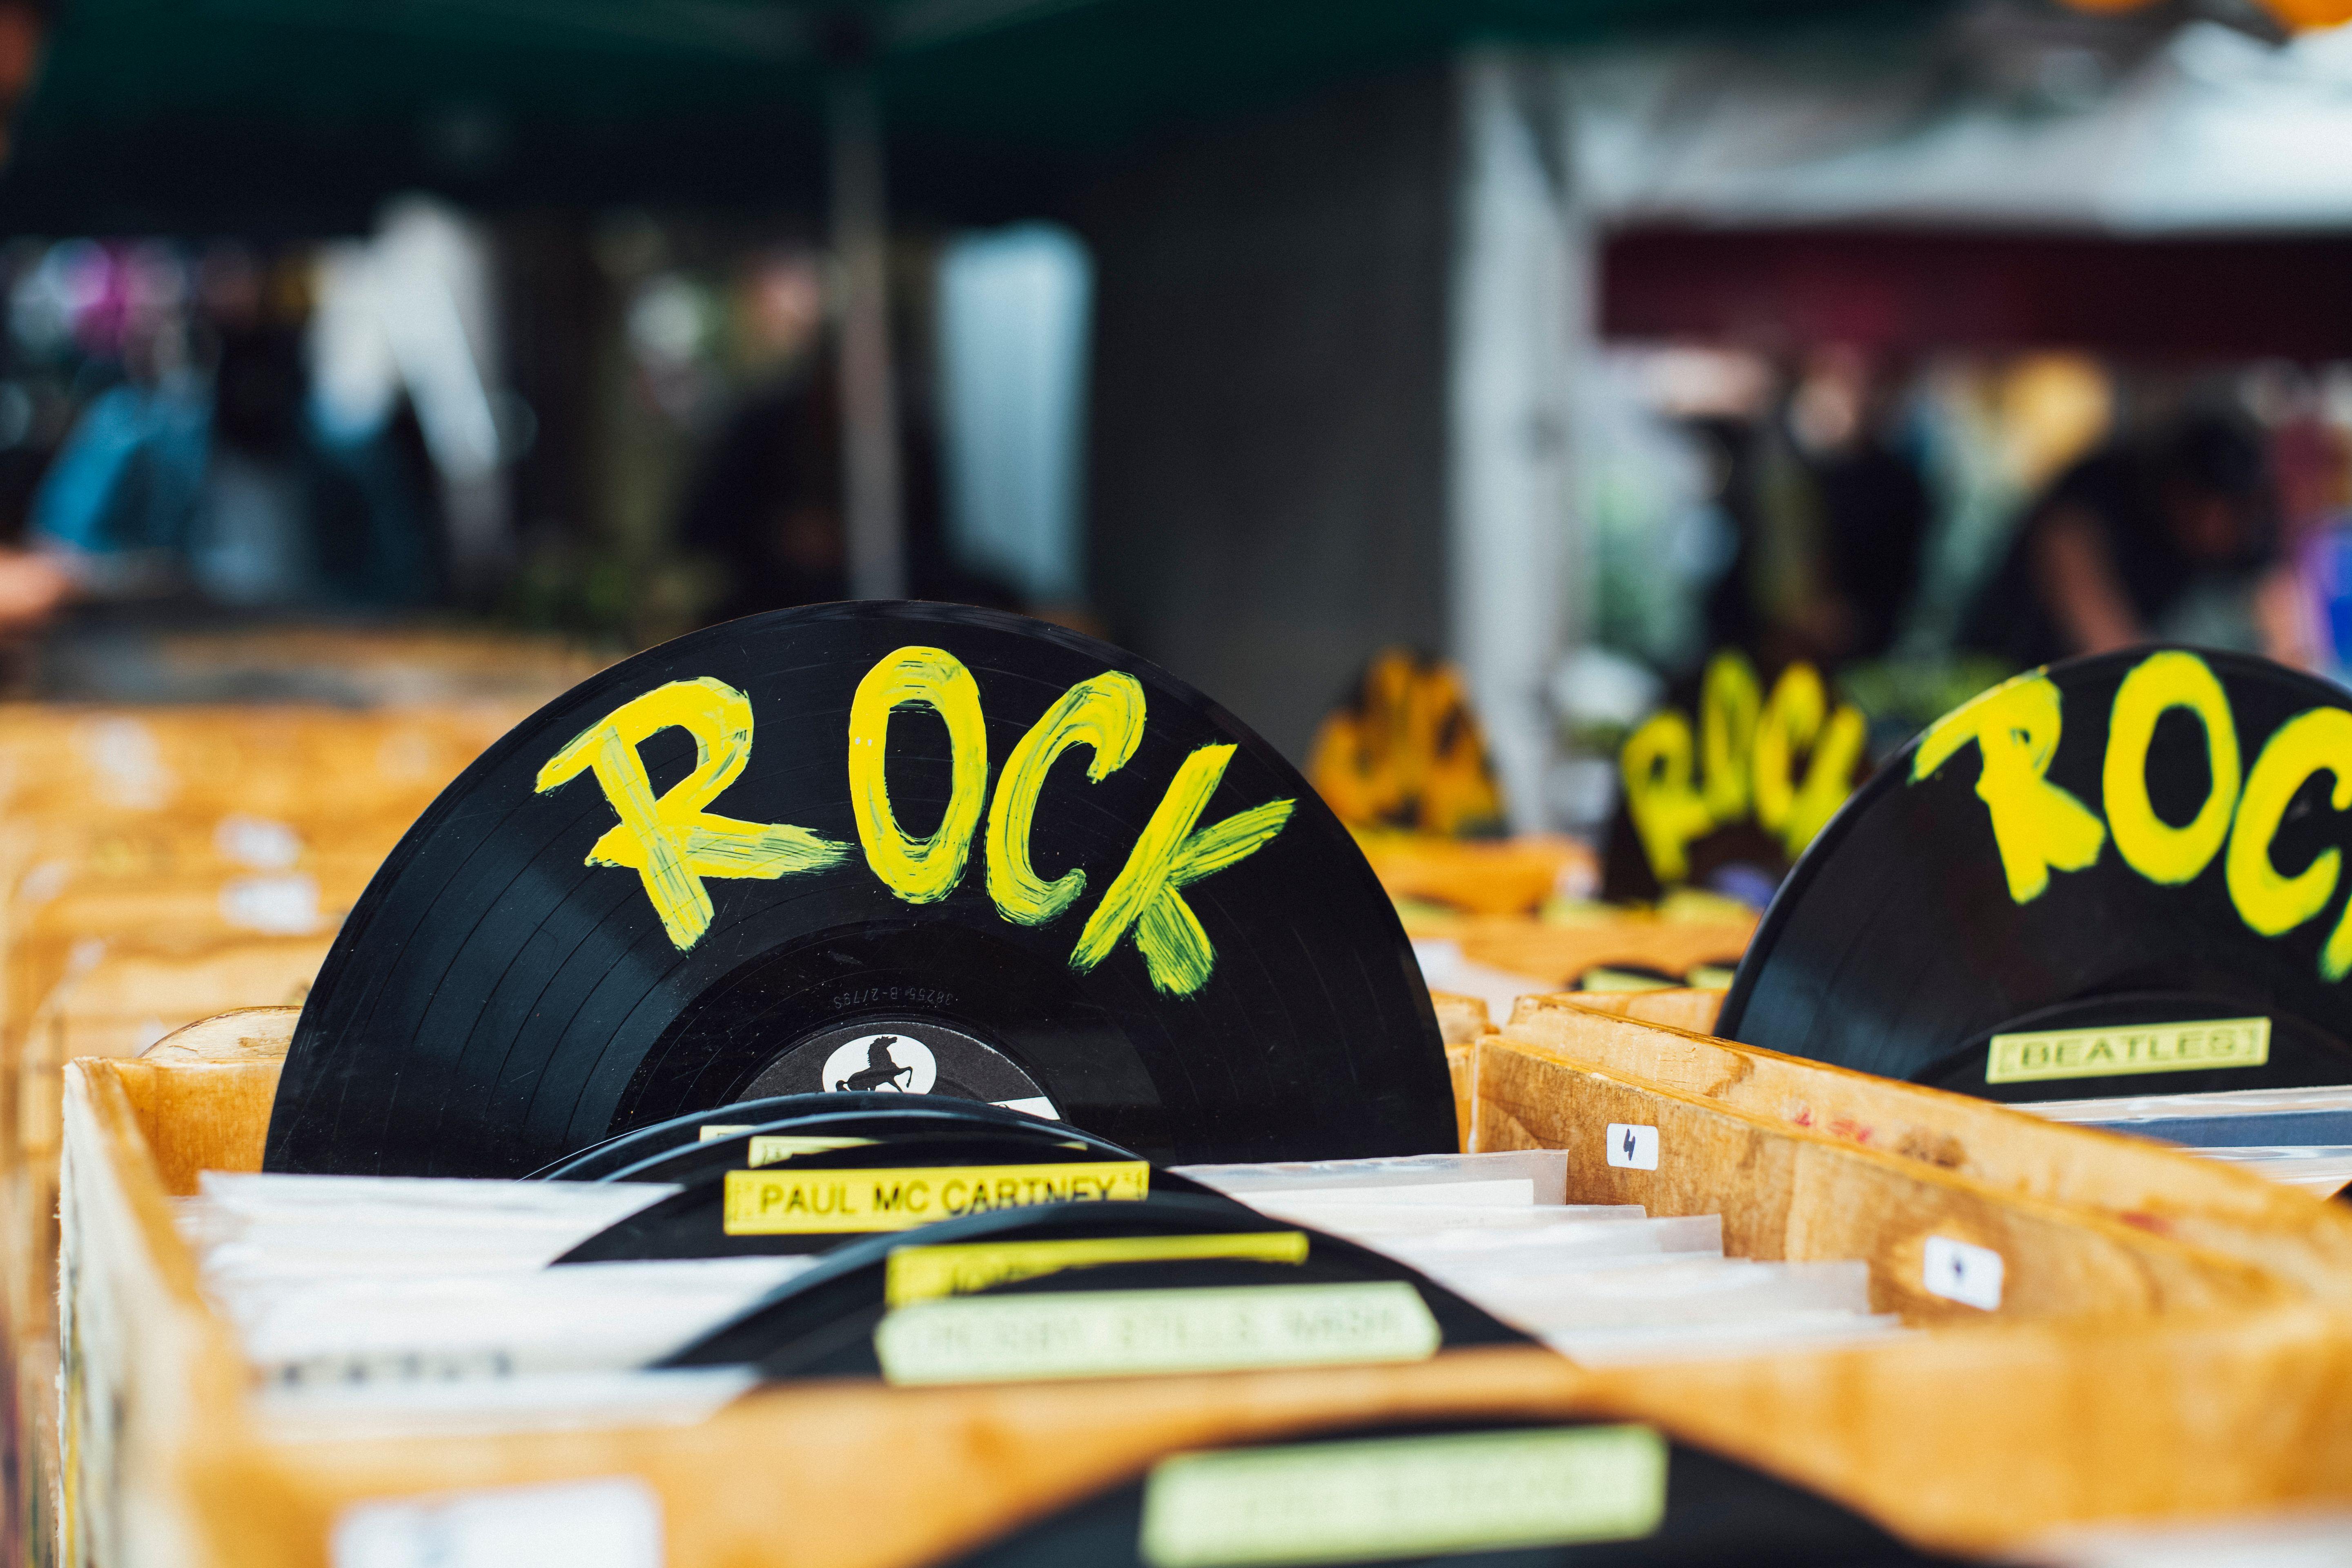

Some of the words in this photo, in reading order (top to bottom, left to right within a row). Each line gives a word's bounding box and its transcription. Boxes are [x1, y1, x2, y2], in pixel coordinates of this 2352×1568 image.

[535, 645, 1298, 1000] ROCK
[1906, 650, 2352, 982] ROC
[2021, 1029, 2234, 1071] BEATLES
[760, 1183, 858, 1215] PAUL
[872, 1181, 930, 1213] MC
[940, 1176, 1116, 1216] CARTNEY
